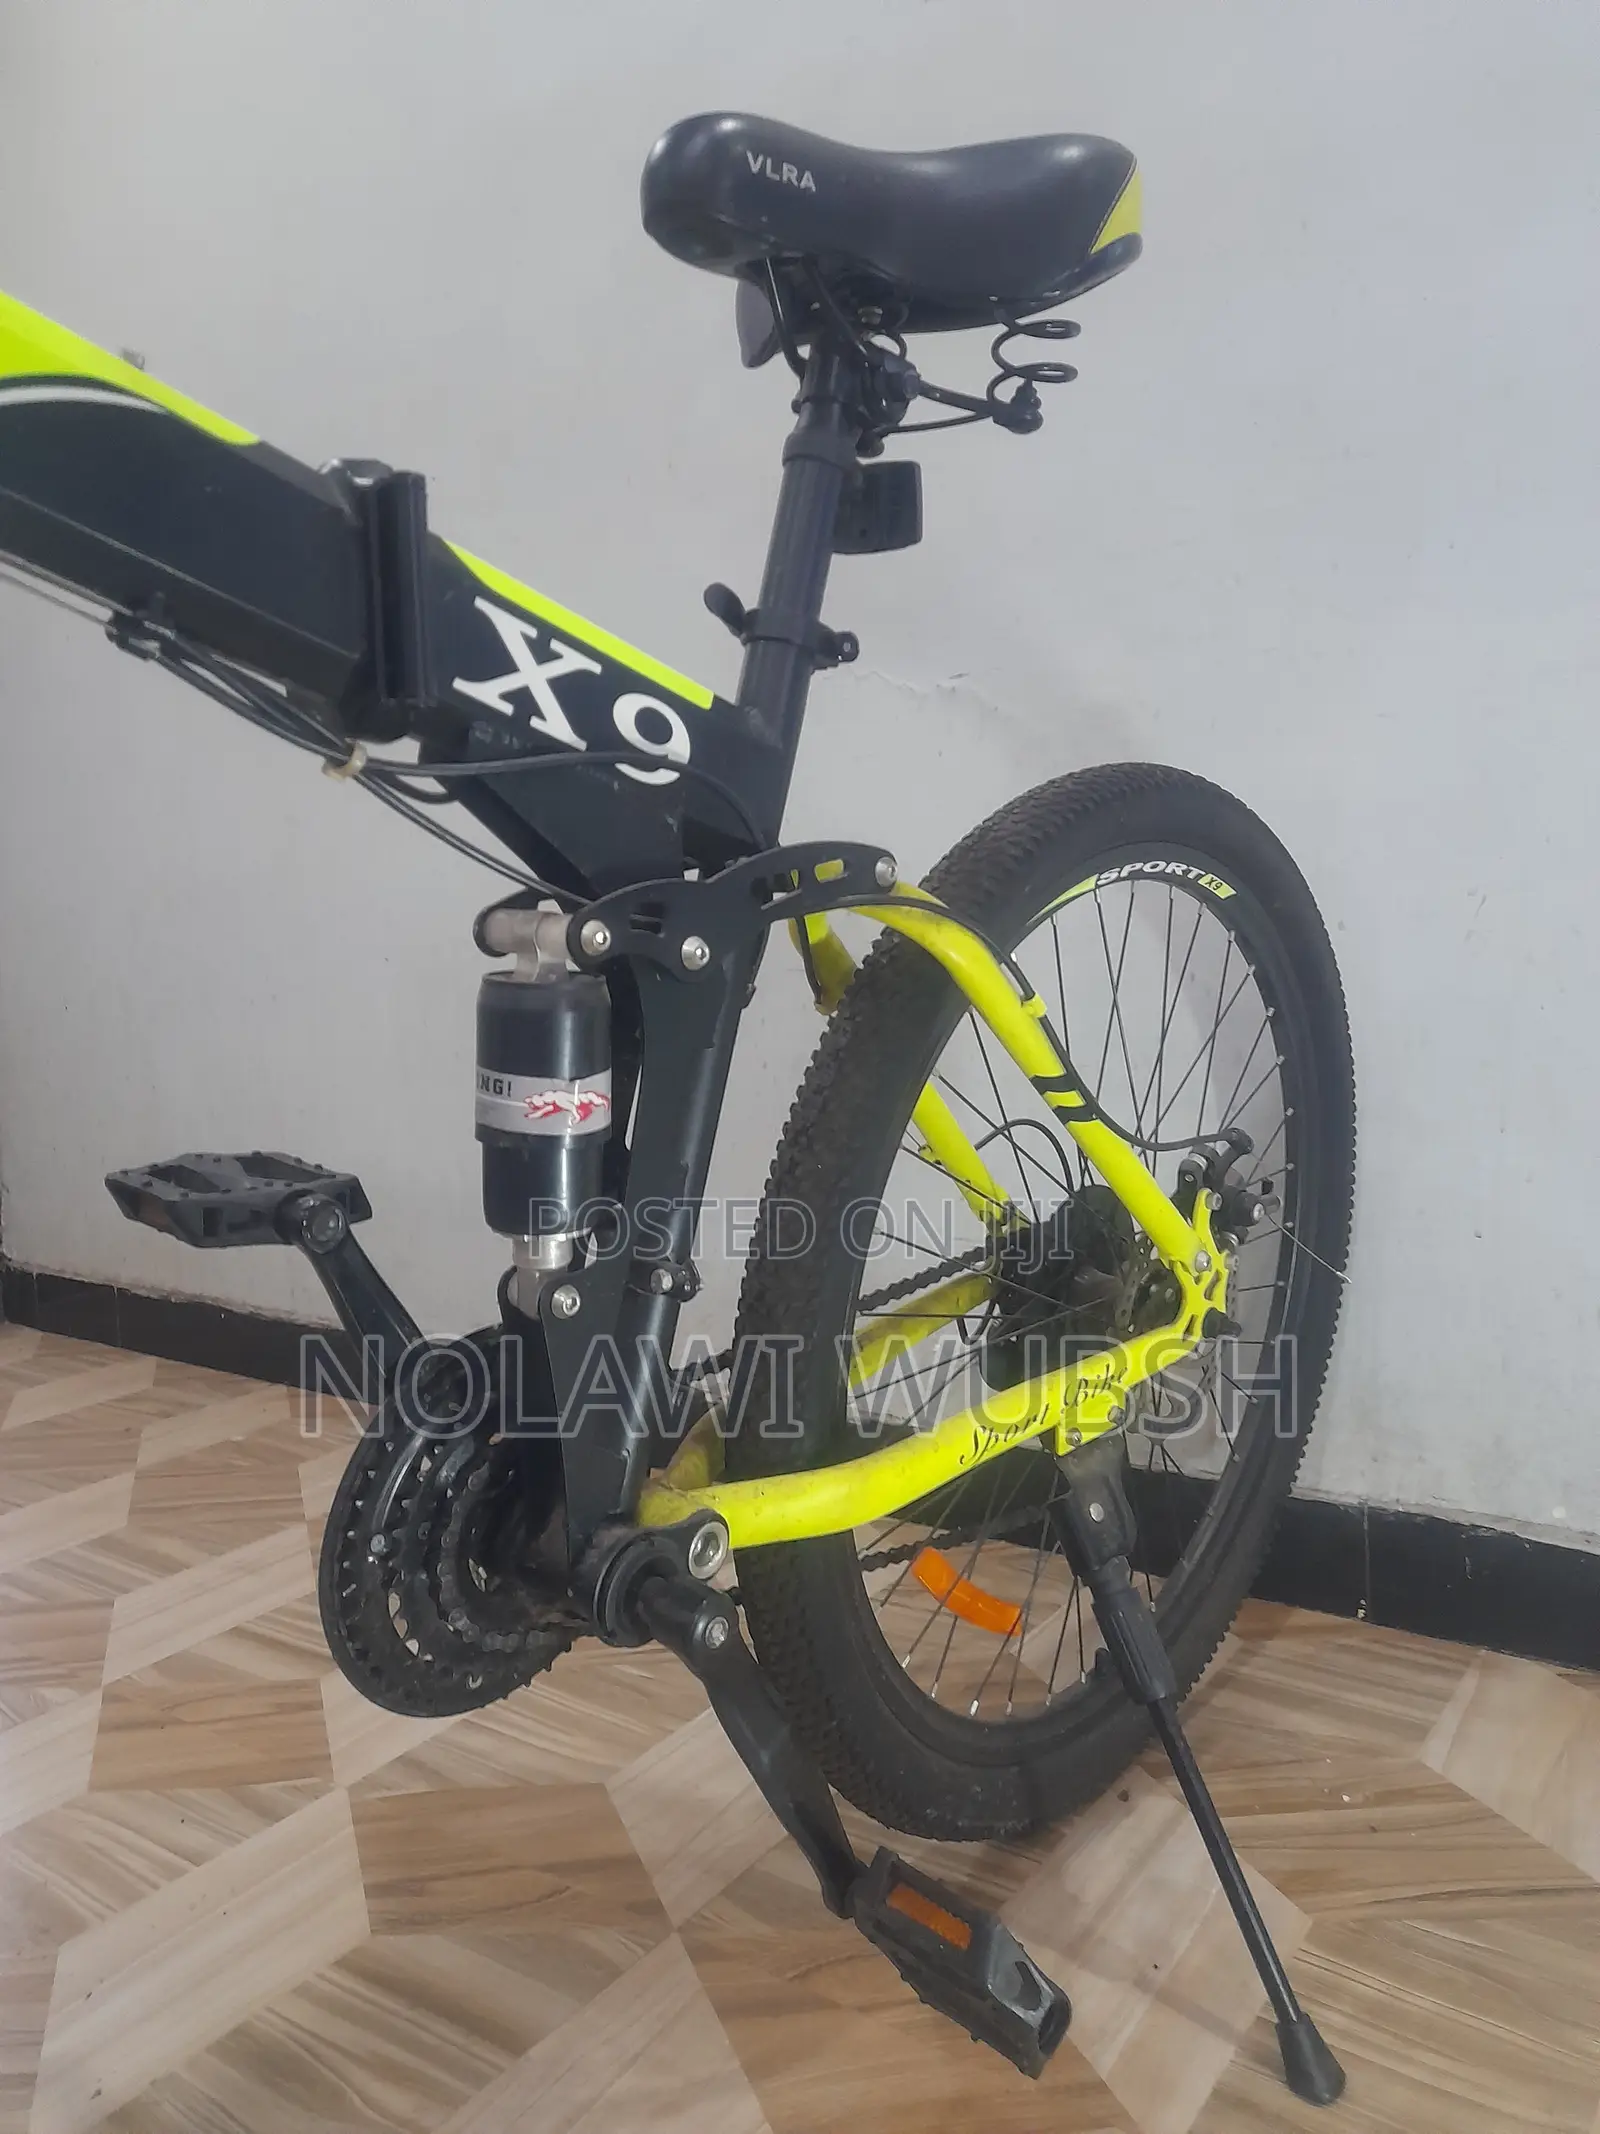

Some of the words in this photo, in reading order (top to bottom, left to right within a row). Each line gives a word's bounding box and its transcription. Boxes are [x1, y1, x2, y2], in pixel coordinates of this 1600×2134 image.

[746, 149, 816, 192] VLRA
[452, 595, 691, 786] X9
[1096, 860, 1206, 886] SPORT
[1204, 876, 1223, 891] X9
[959, 1402, 1050, 1467] Sport
[1060, 1362, 1129, 1415] Bike
